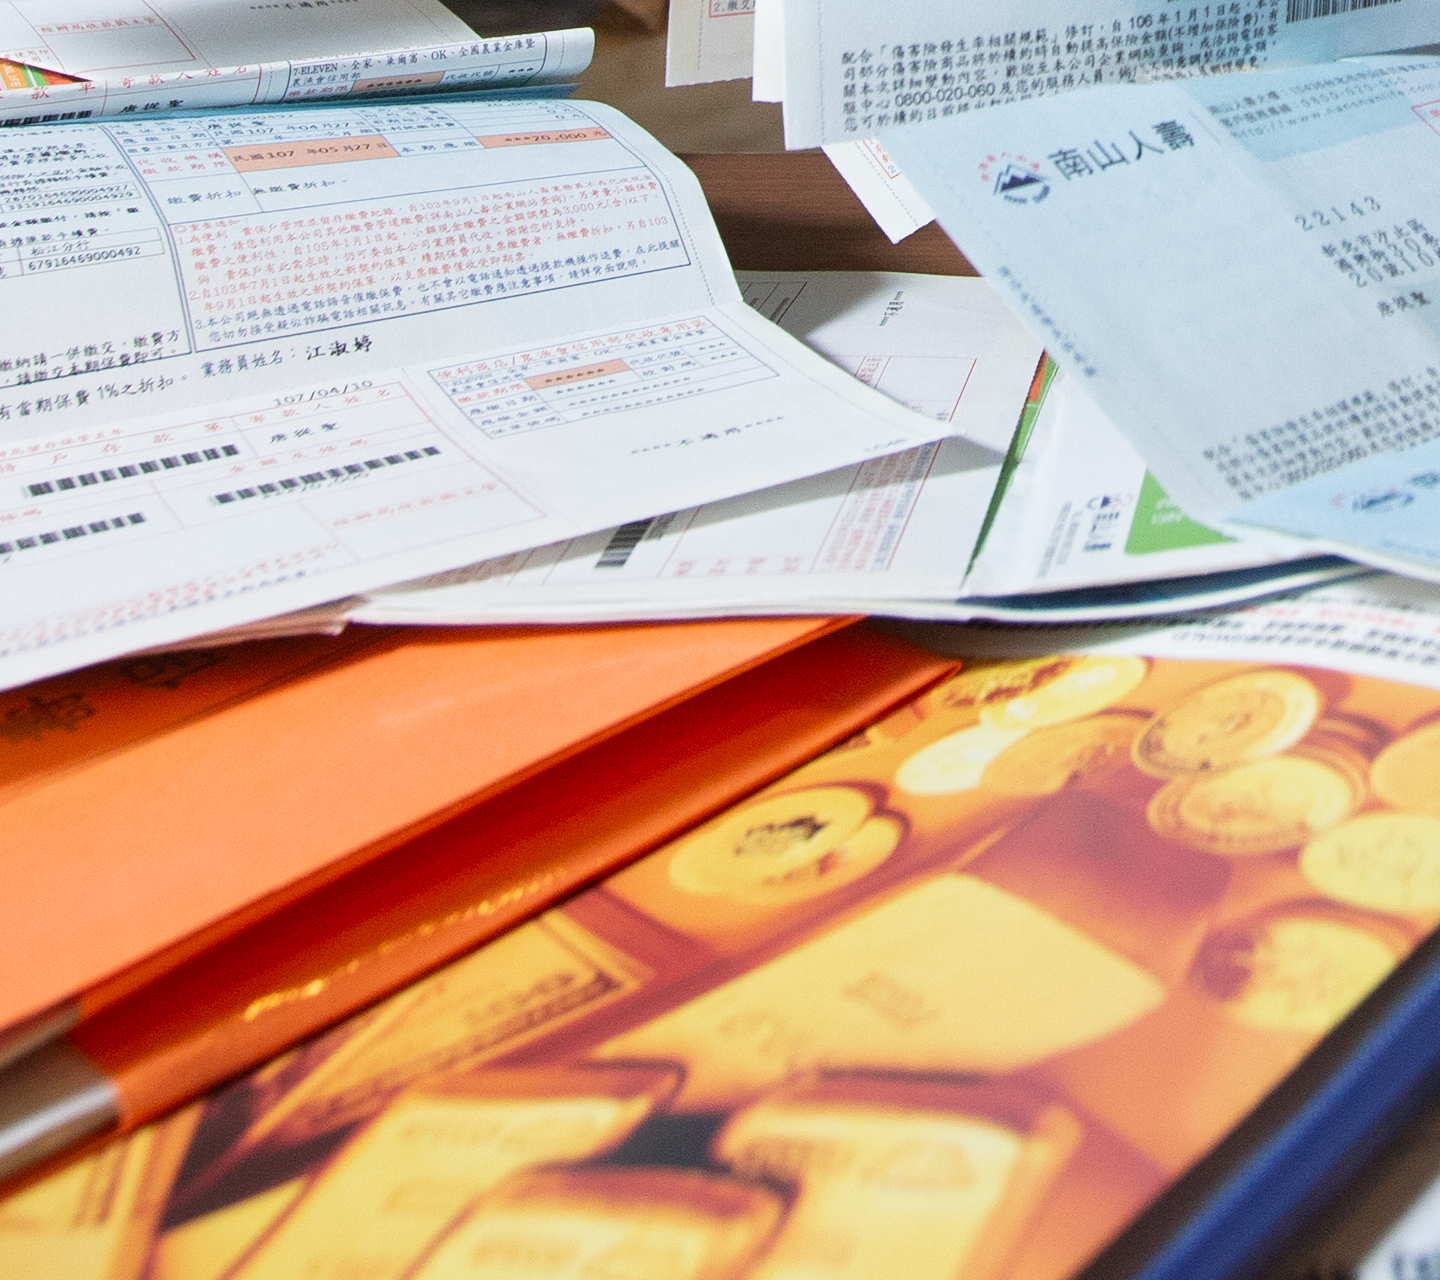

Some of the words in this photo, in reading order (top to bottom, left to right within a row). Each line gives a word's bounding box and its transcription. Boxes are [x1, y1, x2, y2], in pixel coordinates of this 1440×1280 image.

[1048, 119, 1195, 182] 南山人壽
[26, 246, 142, 273] 67916469000492
